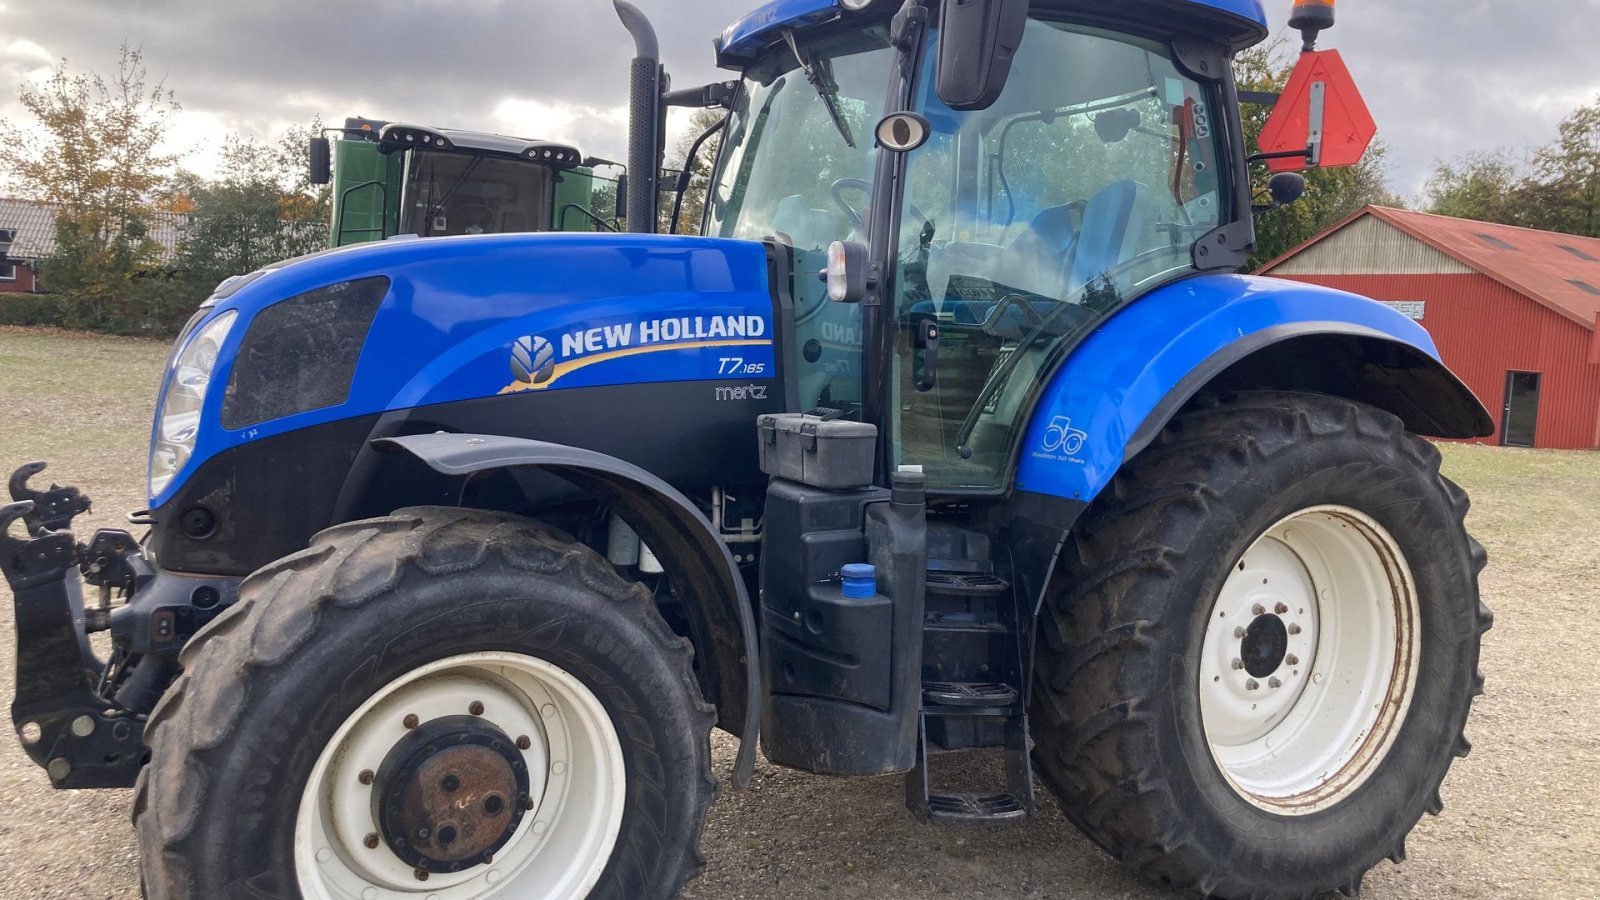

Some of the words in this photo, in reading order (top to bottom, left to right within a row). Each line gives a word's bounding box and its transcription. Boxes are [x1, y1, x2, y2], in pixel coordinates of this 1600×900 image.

[562, 323, 632, 357] NEW
[640, 315, 765, 343] HOLLAND
[717, 357, 765, 374] T7.185
[715, 383, 768, 401] mertz
